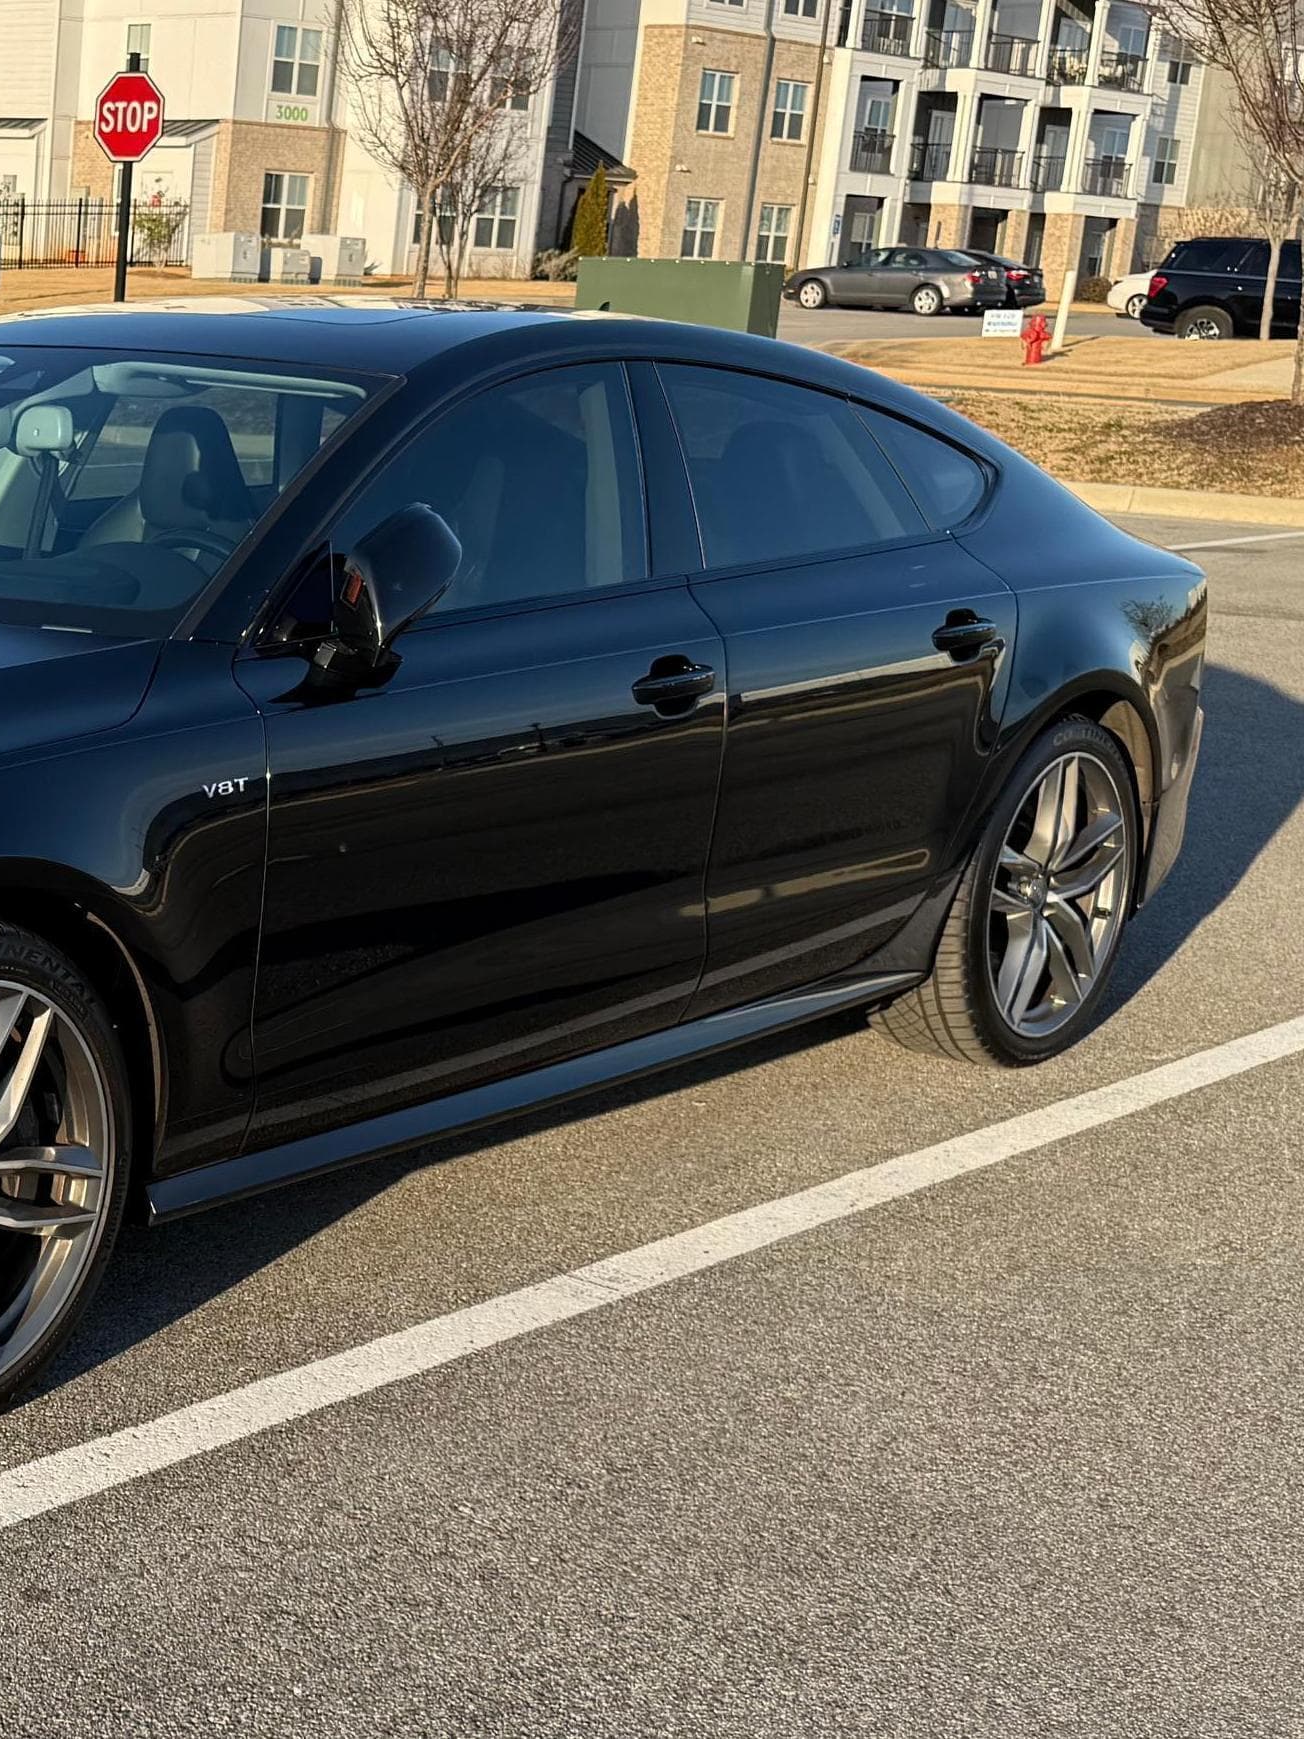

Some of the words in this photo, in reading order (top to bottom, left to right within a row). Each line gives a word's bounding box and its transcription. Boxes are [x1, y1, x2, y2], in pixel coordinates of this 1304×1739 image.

[100, 101, 158, 133] STOP
[276, 104, 308, 121] 3000
[202, 777, 249, 799] V8T
